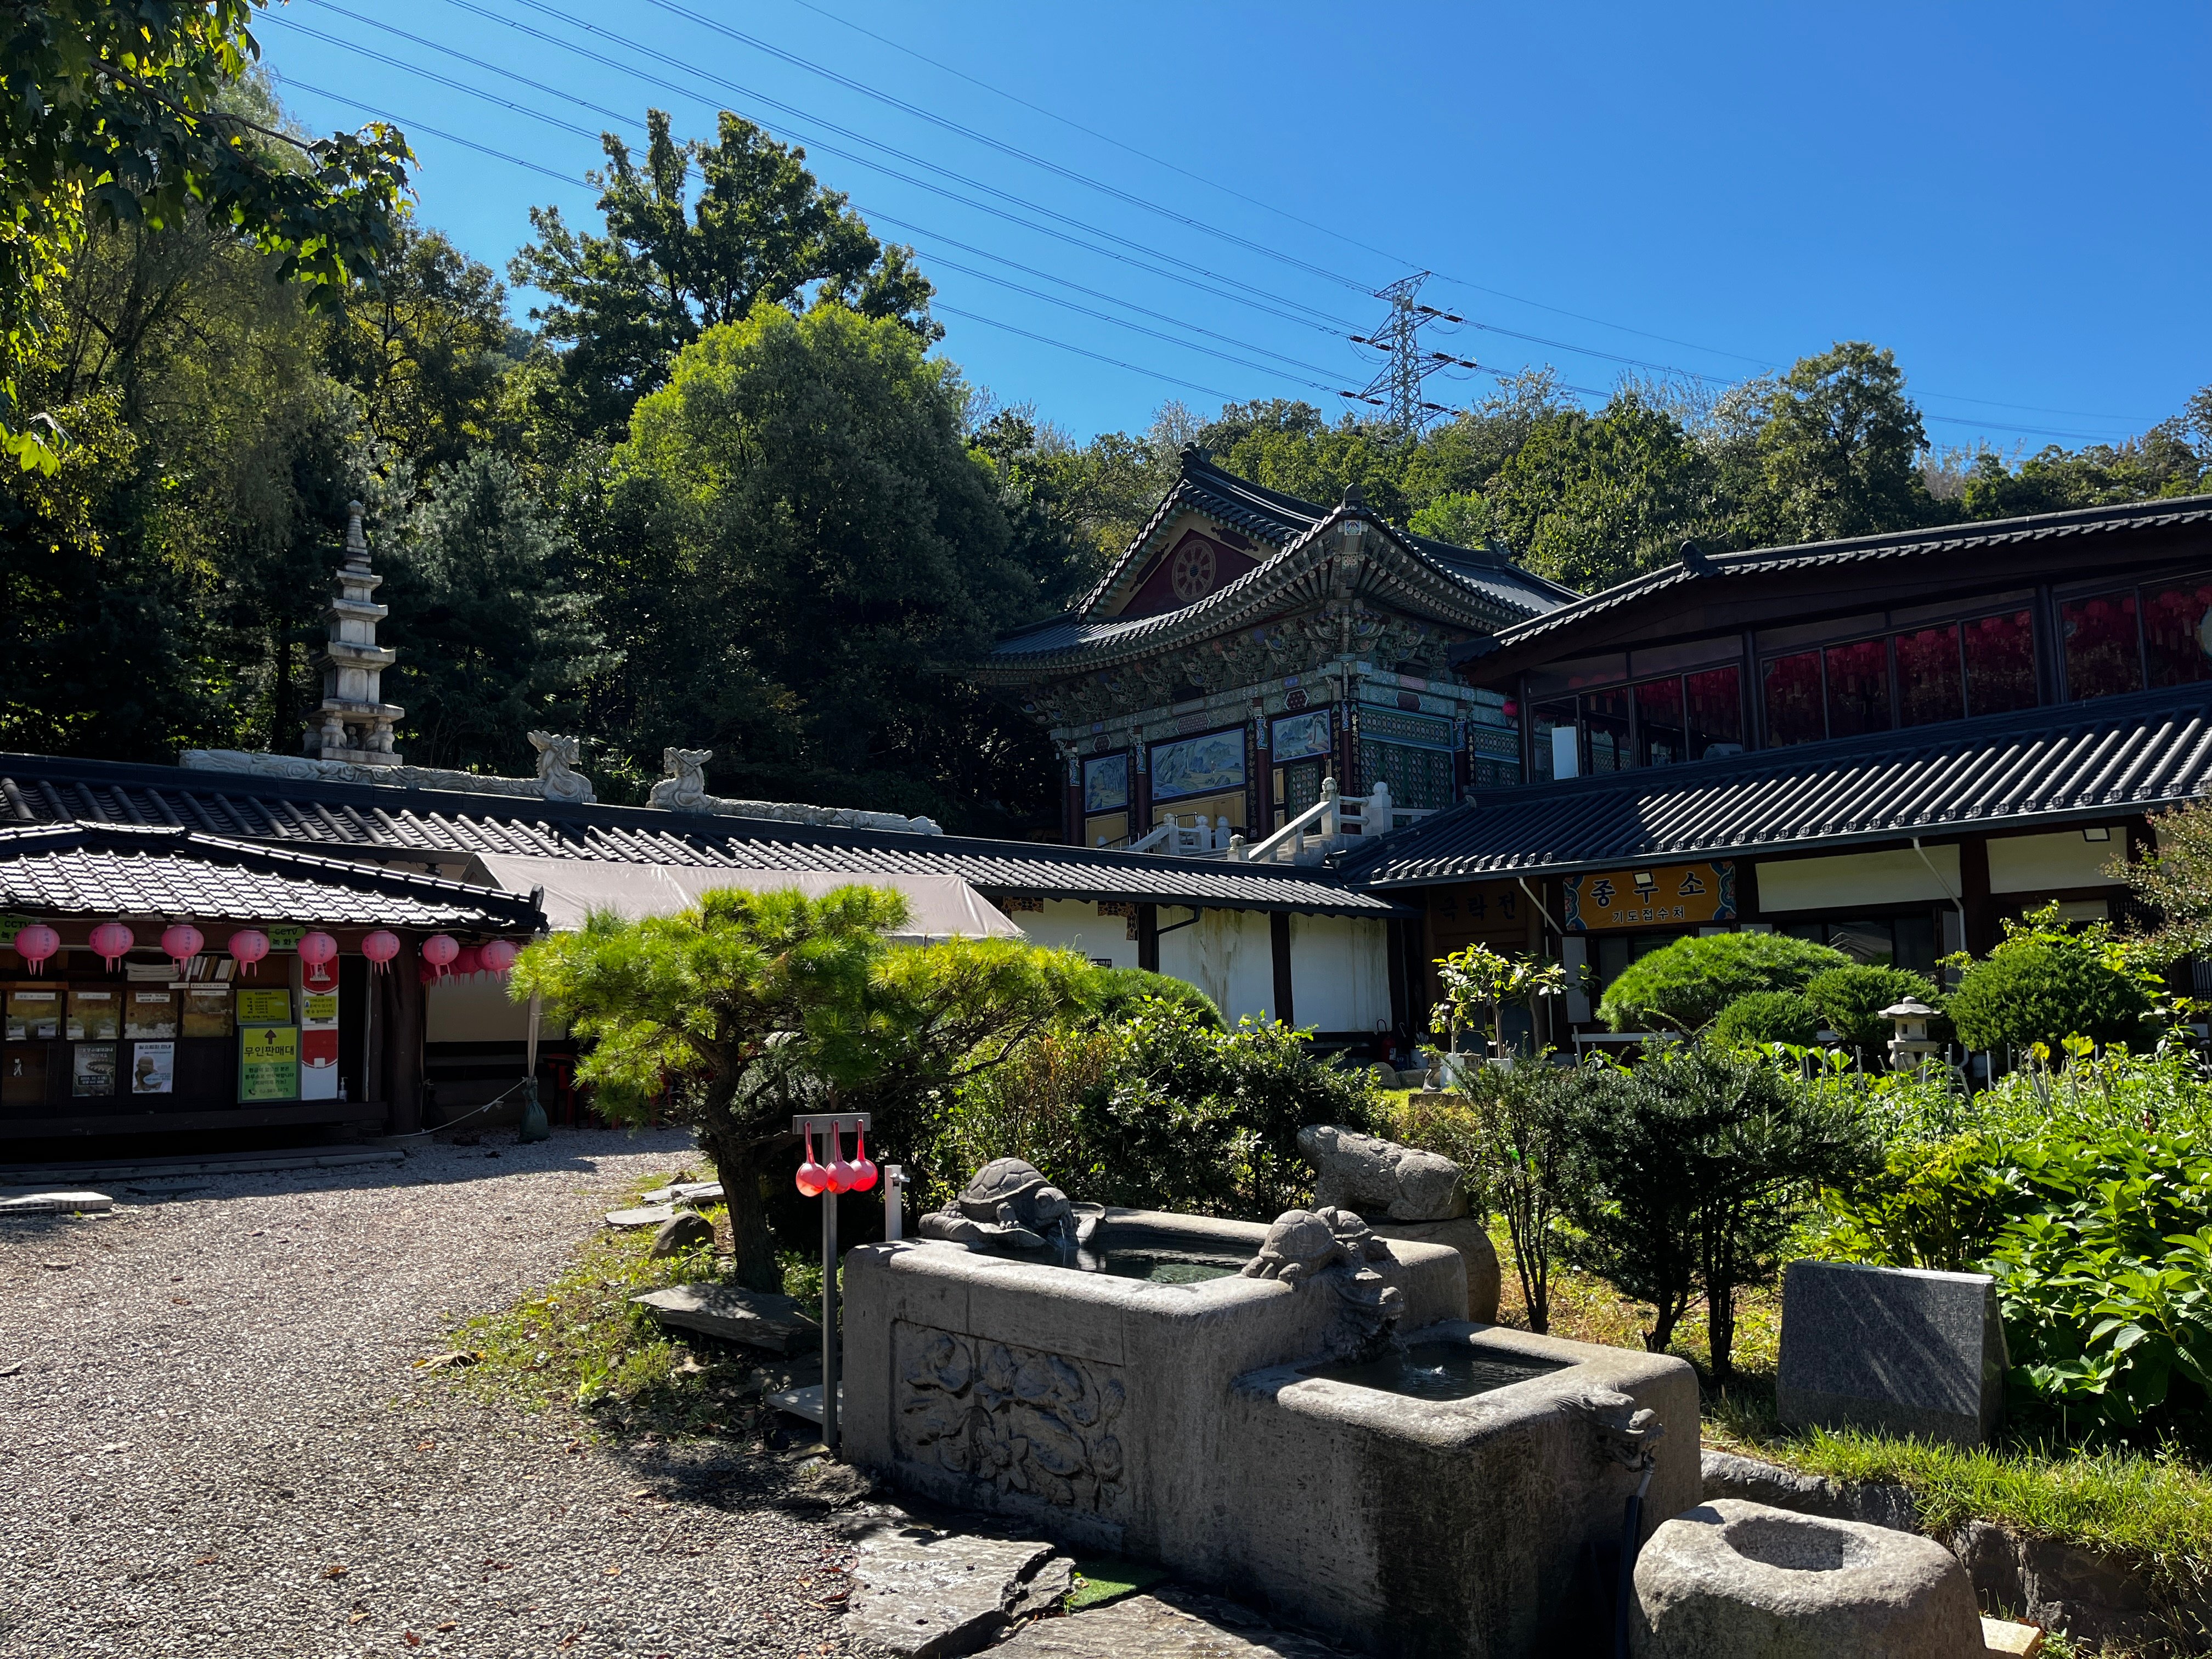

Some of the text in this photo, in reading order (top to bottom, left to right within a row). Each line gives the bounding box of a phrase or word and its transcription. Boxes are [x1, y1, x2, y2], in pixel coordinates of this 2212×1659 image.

[1439, 890, 1515, 923] 극락전
[1612, 906, 1684, 923] 기도접수처
[244, 1045, 294, 1057] 무인판매대
